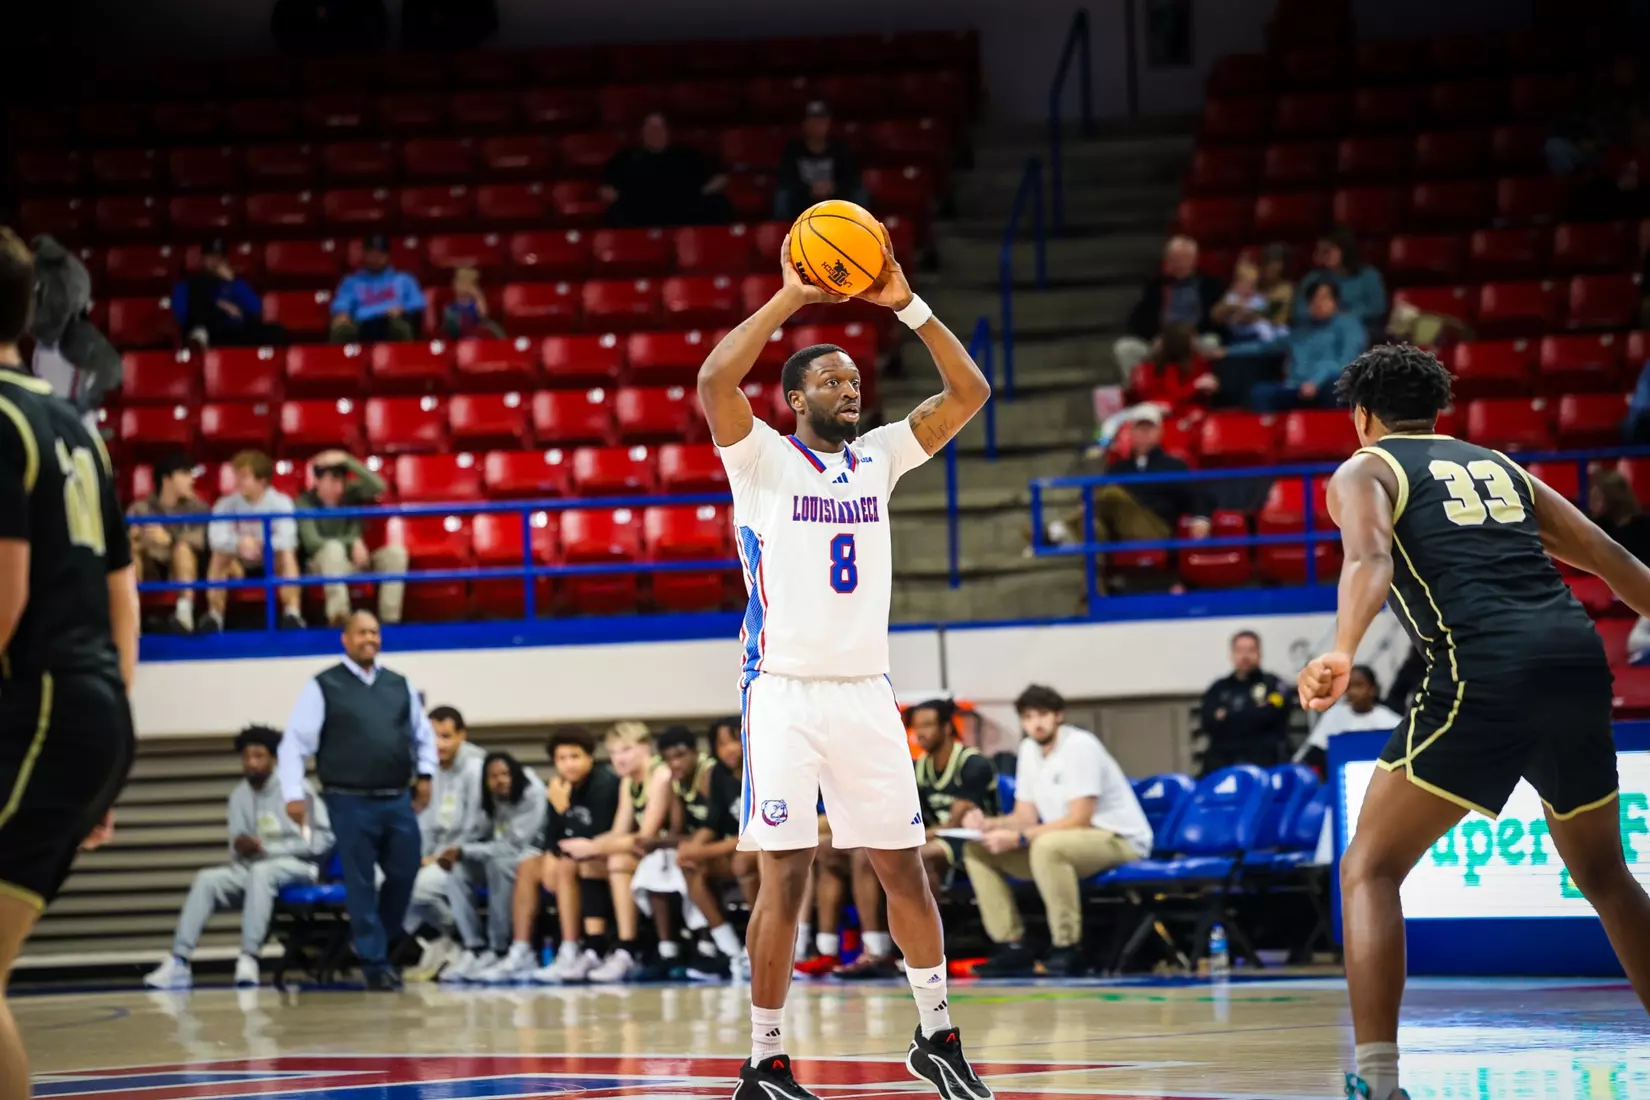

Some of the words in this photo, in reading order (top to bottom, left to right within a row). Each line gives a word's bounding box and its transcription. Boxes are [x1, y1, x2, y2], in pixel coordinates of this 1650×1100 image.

[860, 496, 879, 523] ECH
[1428, 460, 1527, 526] 33
[830, 533, 858, 594] 8
[1424, 818, 1550, 887] uper
